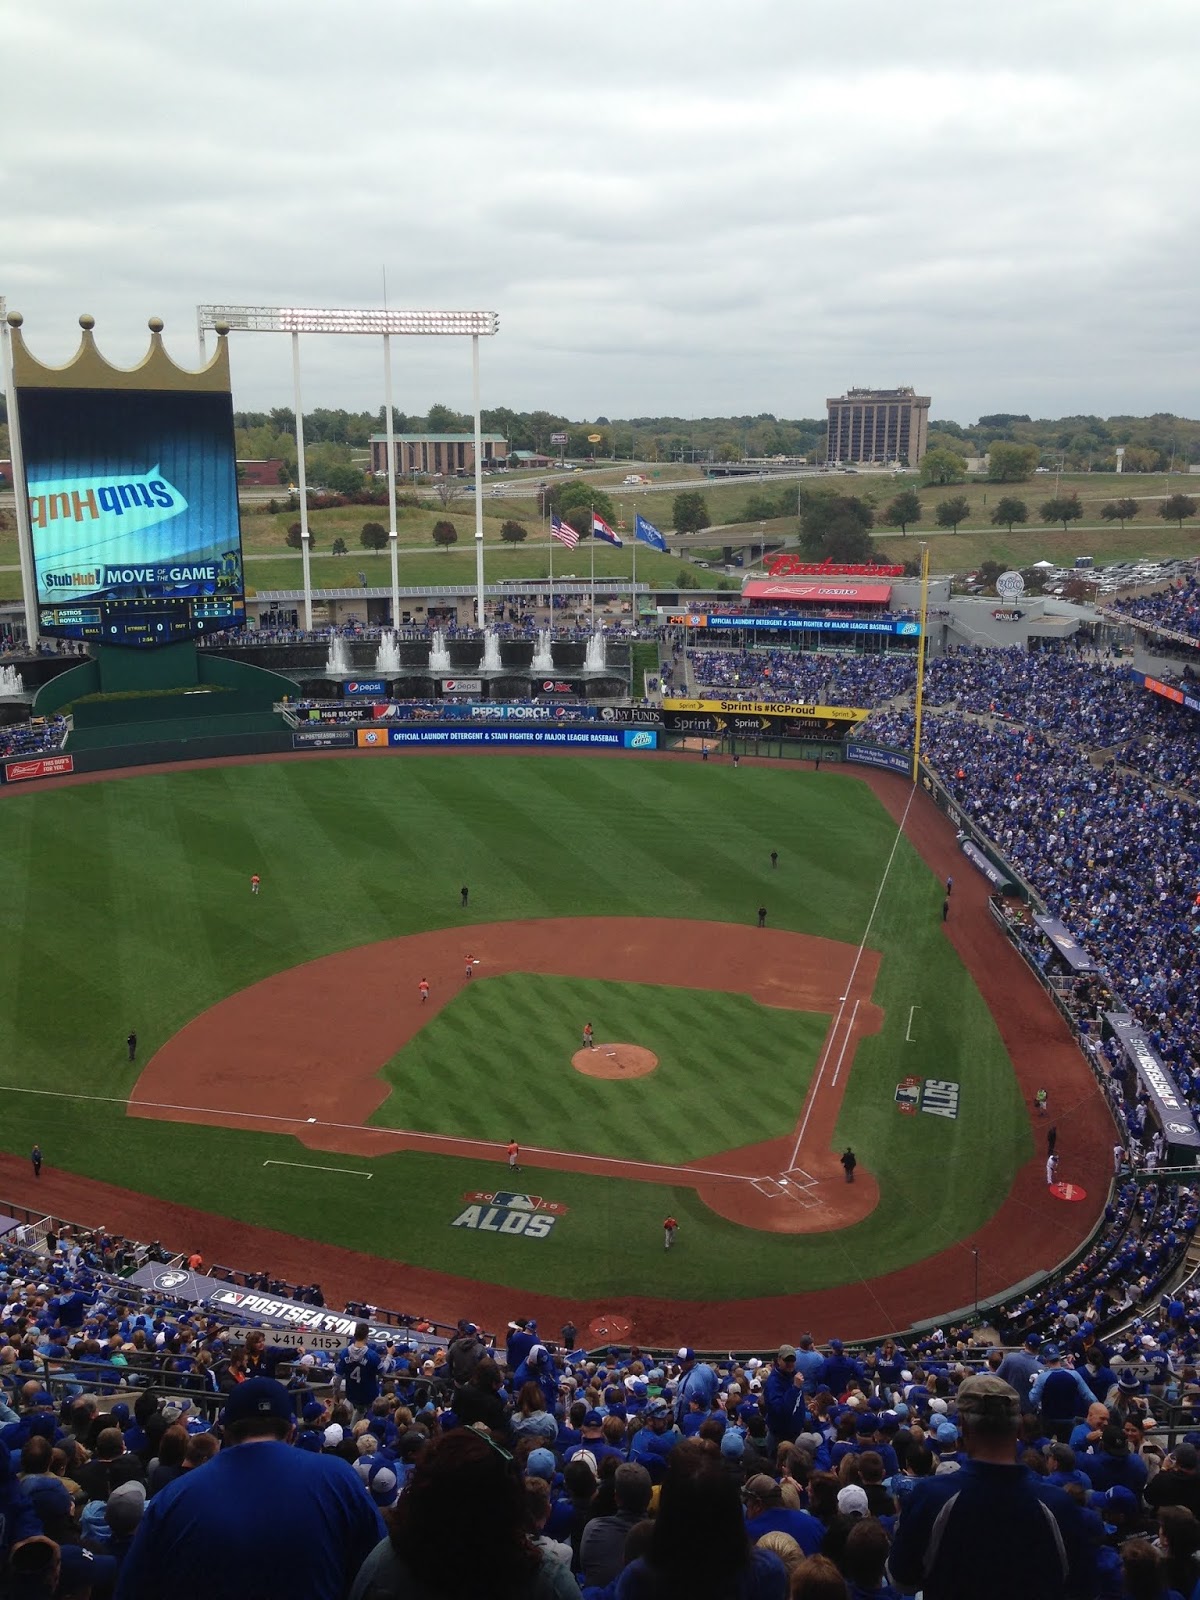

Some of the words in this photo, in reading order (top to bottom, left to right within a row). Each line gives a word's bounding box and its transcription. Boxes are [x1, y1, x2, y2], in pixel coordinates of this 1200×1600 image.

[46, 568, 101, 587] StubHub!
[107, 568, 154, 584] MOVE
[170, 566, 216, 580] GAME
[360, 683, 381, 691] pepsi
[472, 707, 504, 717] PEPSI
[507, 707, 550, 717] PORCH
[721, 702, 751, 711] Sprint
[755, 703, 762, 711] is
[764, 704, 815, 714] #KCProud
[615, 709, 629, 719] IVY
[632, 709, 660, 721] FUNDS
[675, 717, 711, 730] Sprint
[735, 719, 759, 728] Sprint
[1137, 1055, 1177, 1098] POSTSEASON
[922, 1080, 959, 1118] ALDS
[451, 1205, 555, 1238] ALDS
[238, 1295, 357, 1336] POSTSEASON
[283, 1335, 304, 1346] 414
[311, 1338, 331, 1348] 415
[350, 1366, 361, 1383] 4
[1117, 1368, 1139, 1376] 47
